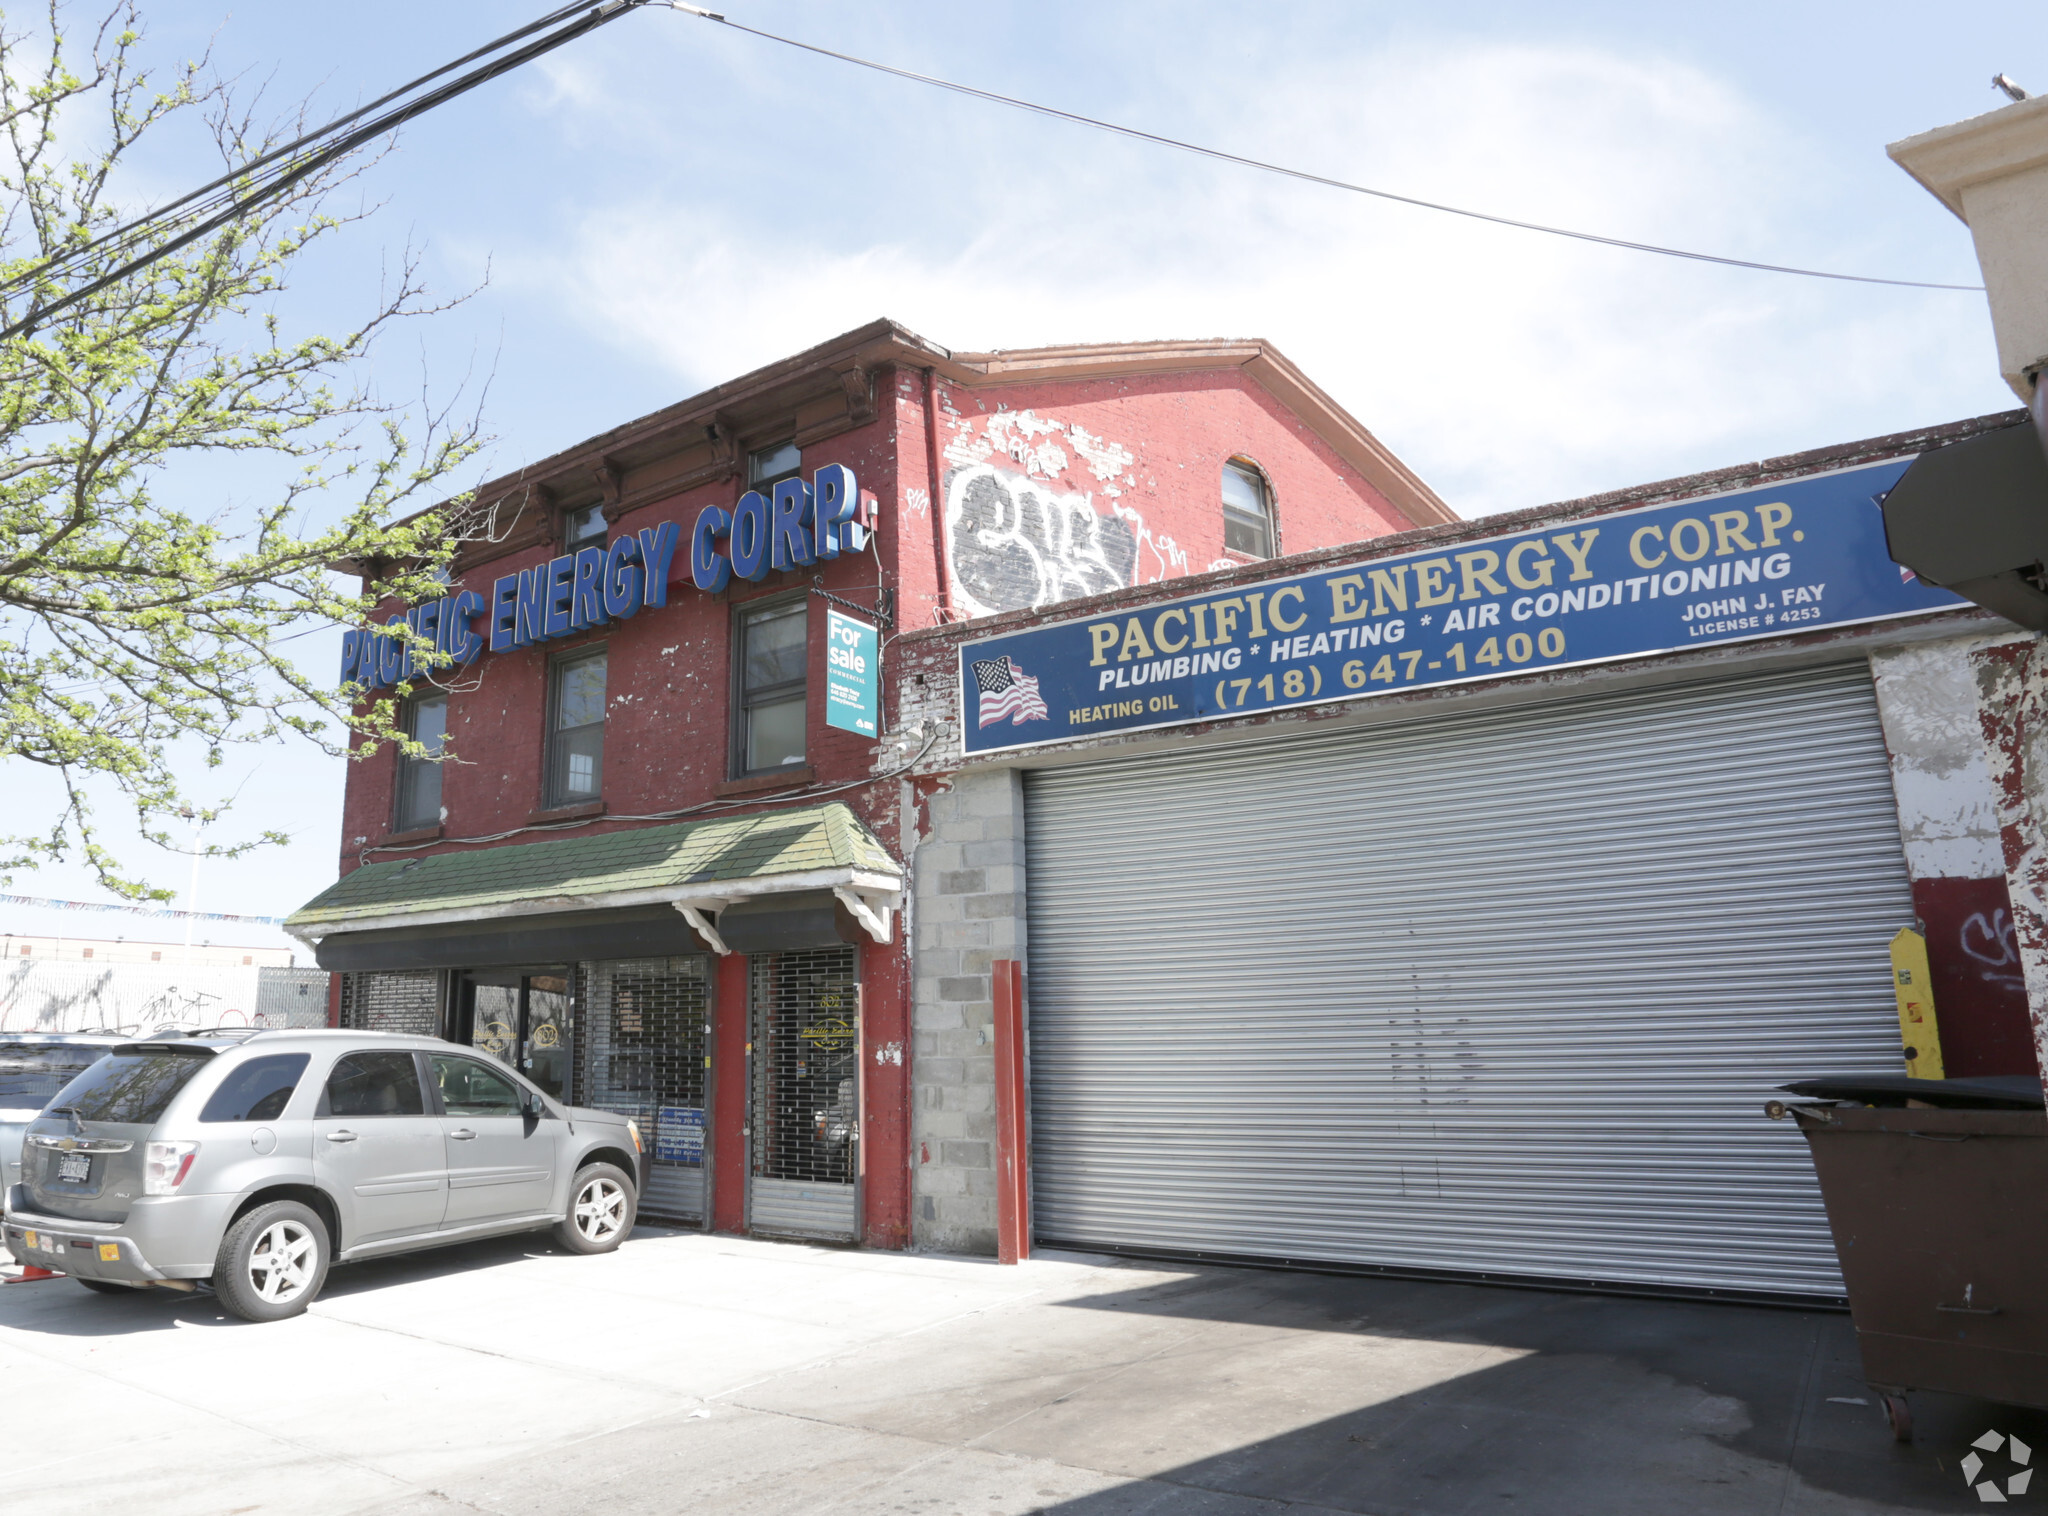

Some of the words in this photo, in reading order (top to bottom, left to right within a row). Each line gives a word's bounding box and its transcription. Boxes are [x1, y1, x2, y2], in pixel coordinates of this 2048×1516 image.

[490, 520, 681, 653] ENERGY
[691, 463, 866, 594] CORP.
[1088, 585, 1308, 667] PACIFIC
[1326, 528, 1600, 624] ENERGY
[1629, 502, 1805, 569] CORP.
[1681, 594, 1747, 622] JOHN
[1754, 592, 1775, 611] J.
[1782, 583, 1827, 606] FAY
[830, 617, 862, 648] For
[1098, 647, 1242, 691] PLUMBING
[1270, 619, 1406, 663] HEATING
[1442, 603, 1501, 635] AIR
[1511, 552, 1792, 622] CONDITIONING
[1689, 616, 1760, 637] LICENSE
[1764, 613, 1775, 626] #
[1780, 607, 1822, 624] 4253
[829, 646, 866, 674] sale
[1215, 665, 1322, 710] (718)
[1341, 626, 1567, 690] 647-1400
[1068, 699, 1143, 725] HEATING
[1148, 694, 1179, 714] OIL
